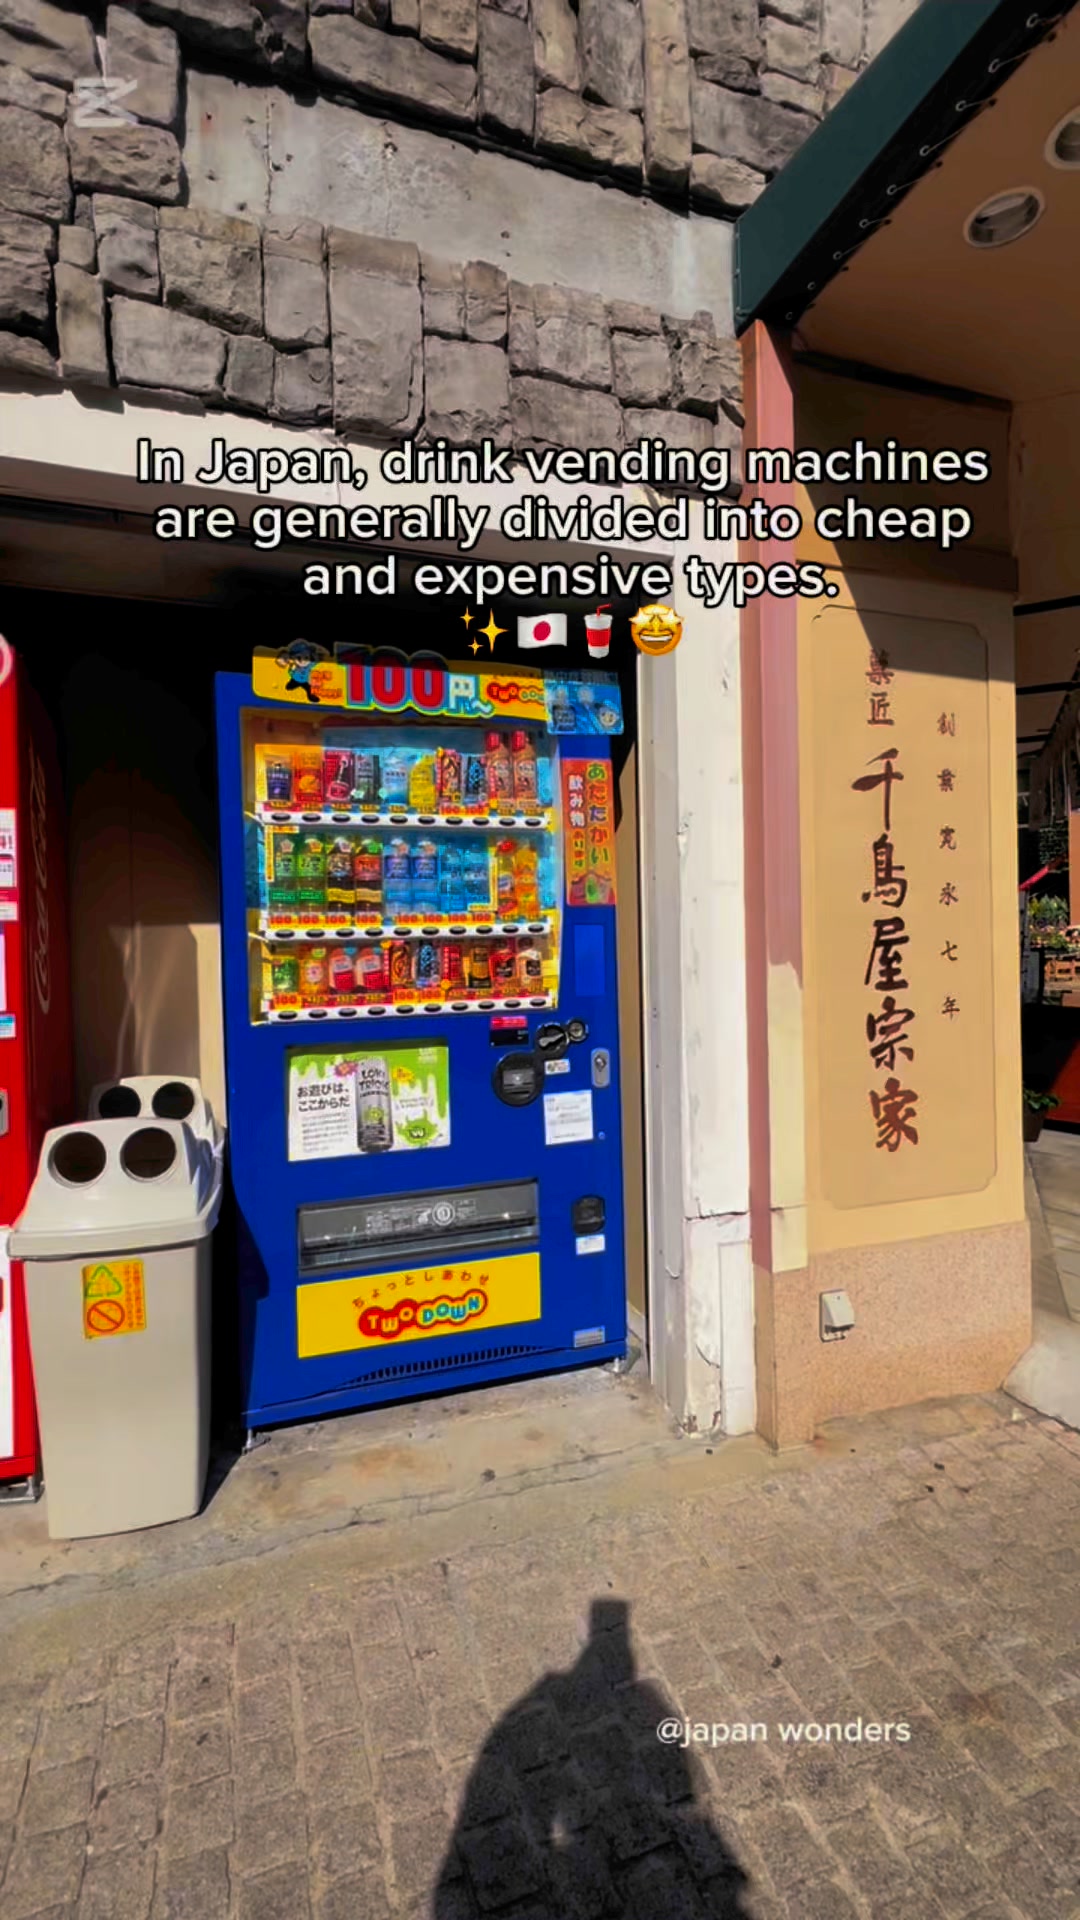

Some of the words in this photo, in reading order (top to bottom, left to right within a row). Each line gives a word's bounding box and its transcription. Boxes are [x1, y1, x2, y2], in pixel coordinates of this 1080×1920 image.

[588, 762, 609, 865] あたたかい
[936, 711, 961, 1019] 創業寛永七年
[851, 747, 919, 1153] 千鳥屋宗家
[298, 1096, 350, 1112] ここからだ
[367, 1306, 414, 1333] TWO
[422, 1295, 480, 1323] DOWN
